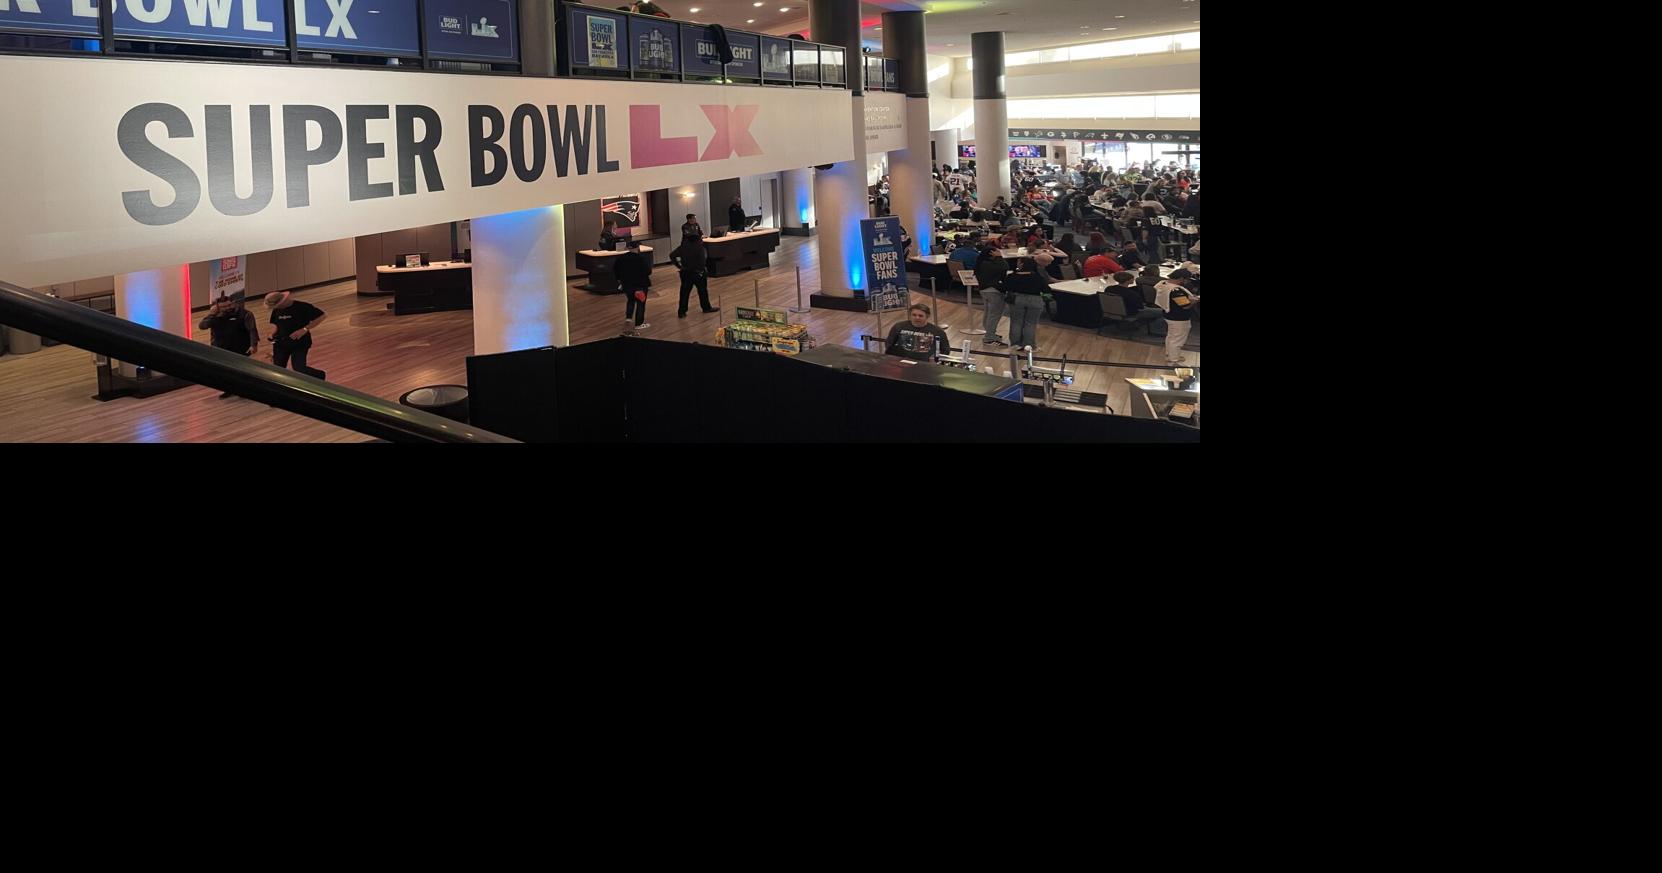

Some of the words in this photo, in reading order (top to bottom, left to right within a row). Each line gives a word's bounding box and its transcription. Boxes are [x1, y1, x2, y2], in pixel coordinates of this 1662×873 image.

[294, 0, 358, 39] LX
[440, 21, 461, 29] LIGHT
[591, 22, 613, 34] SUPER
[591, 33, 613, 44] BOWL
[117, 102, 446, 226] SUPER
[468, 104, 620, 188] BOWL
[629, 104, 764, 169] LX
[950, 177, 960, 186] 21
[871, 251, 898, 263] SUPER
[874, 261, 898, 271] BOWL
[876, 269, 898, 280] FANS
